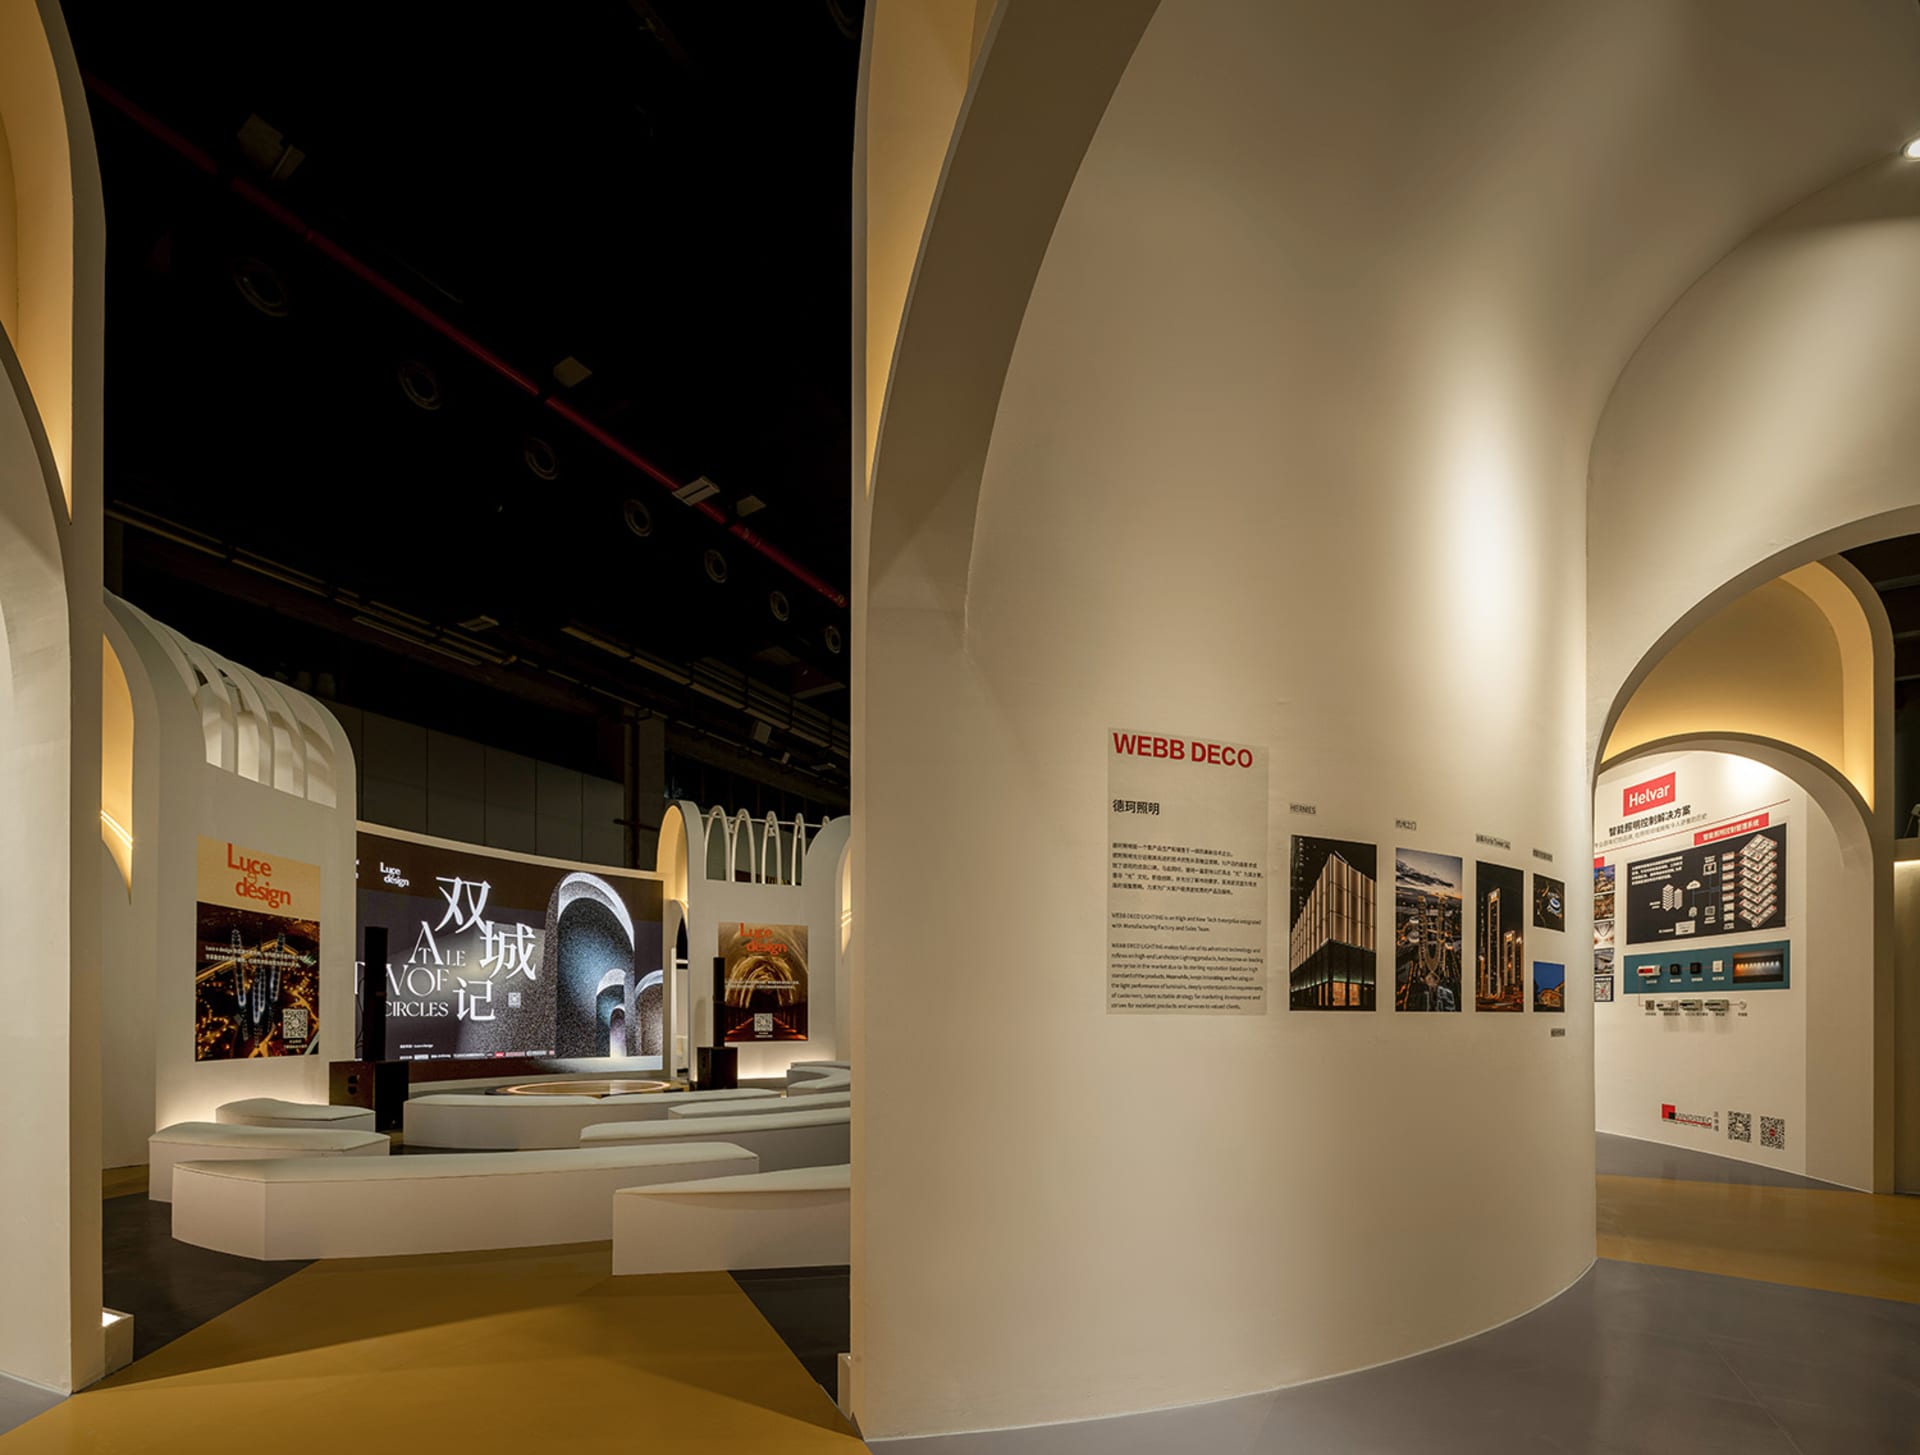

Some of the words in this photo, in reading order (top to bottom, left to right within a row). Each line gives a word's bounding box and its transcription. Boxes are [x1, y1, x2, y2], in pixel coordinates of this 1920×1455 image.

[1112, 732, 1185, 761] WEBB
[1191, 741, 1253, 769] DECO
[1628, 784, 1671, 809] Helvar
[1112, 799, 1160, 815] 德珂照明
[227, 842, 272, 877] Luce
[380, 861, 401, 876] Luce
[384, 874, 410, 888] design
[235, 876, 292, 909] design
[739, 922, 773, 940] Luce
[745, 940, 788, 956] design
